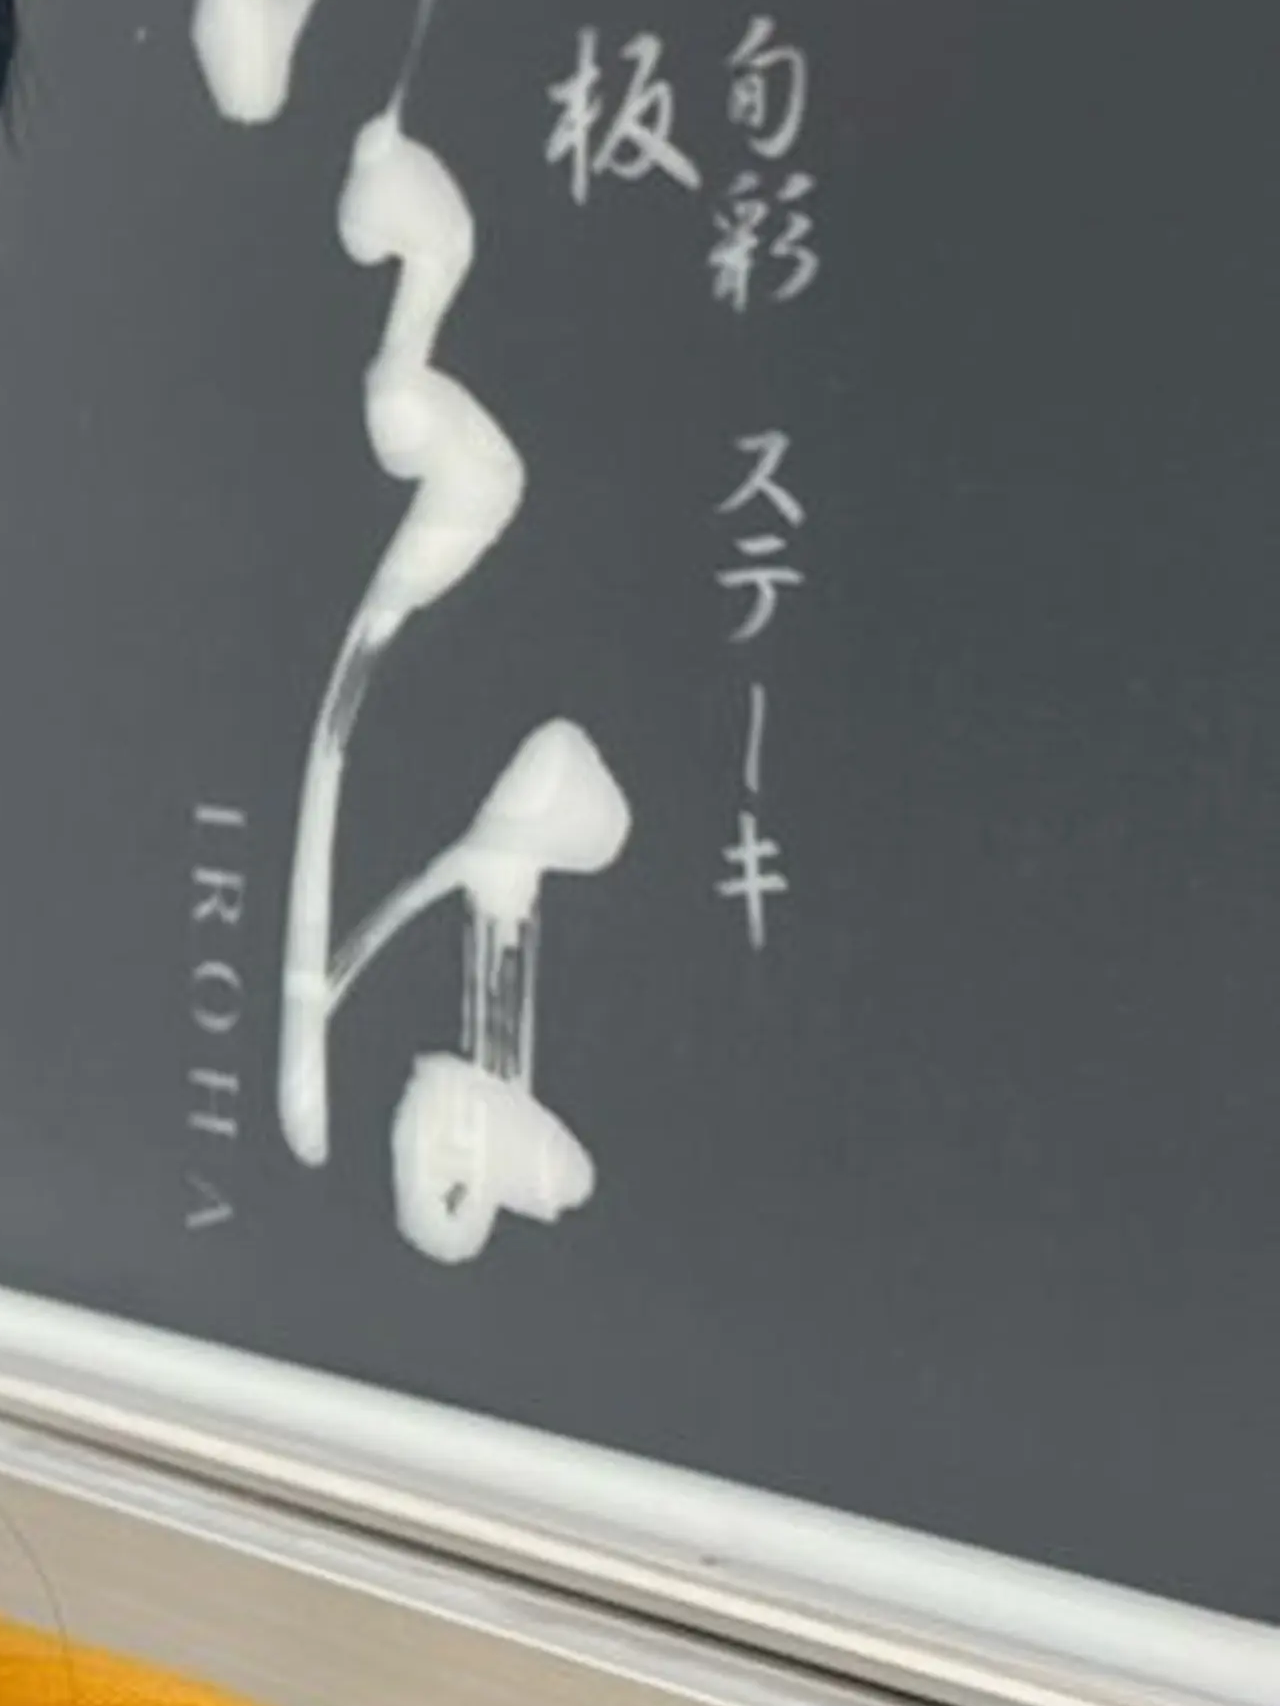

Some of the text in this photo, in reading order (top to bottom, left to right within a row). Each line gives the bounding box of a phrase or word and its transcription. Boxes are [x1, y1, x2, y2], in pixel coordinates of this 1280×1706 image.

[714, 429, 806, 951] ステーキ
[184, 803, 246, 1230] IROHA
